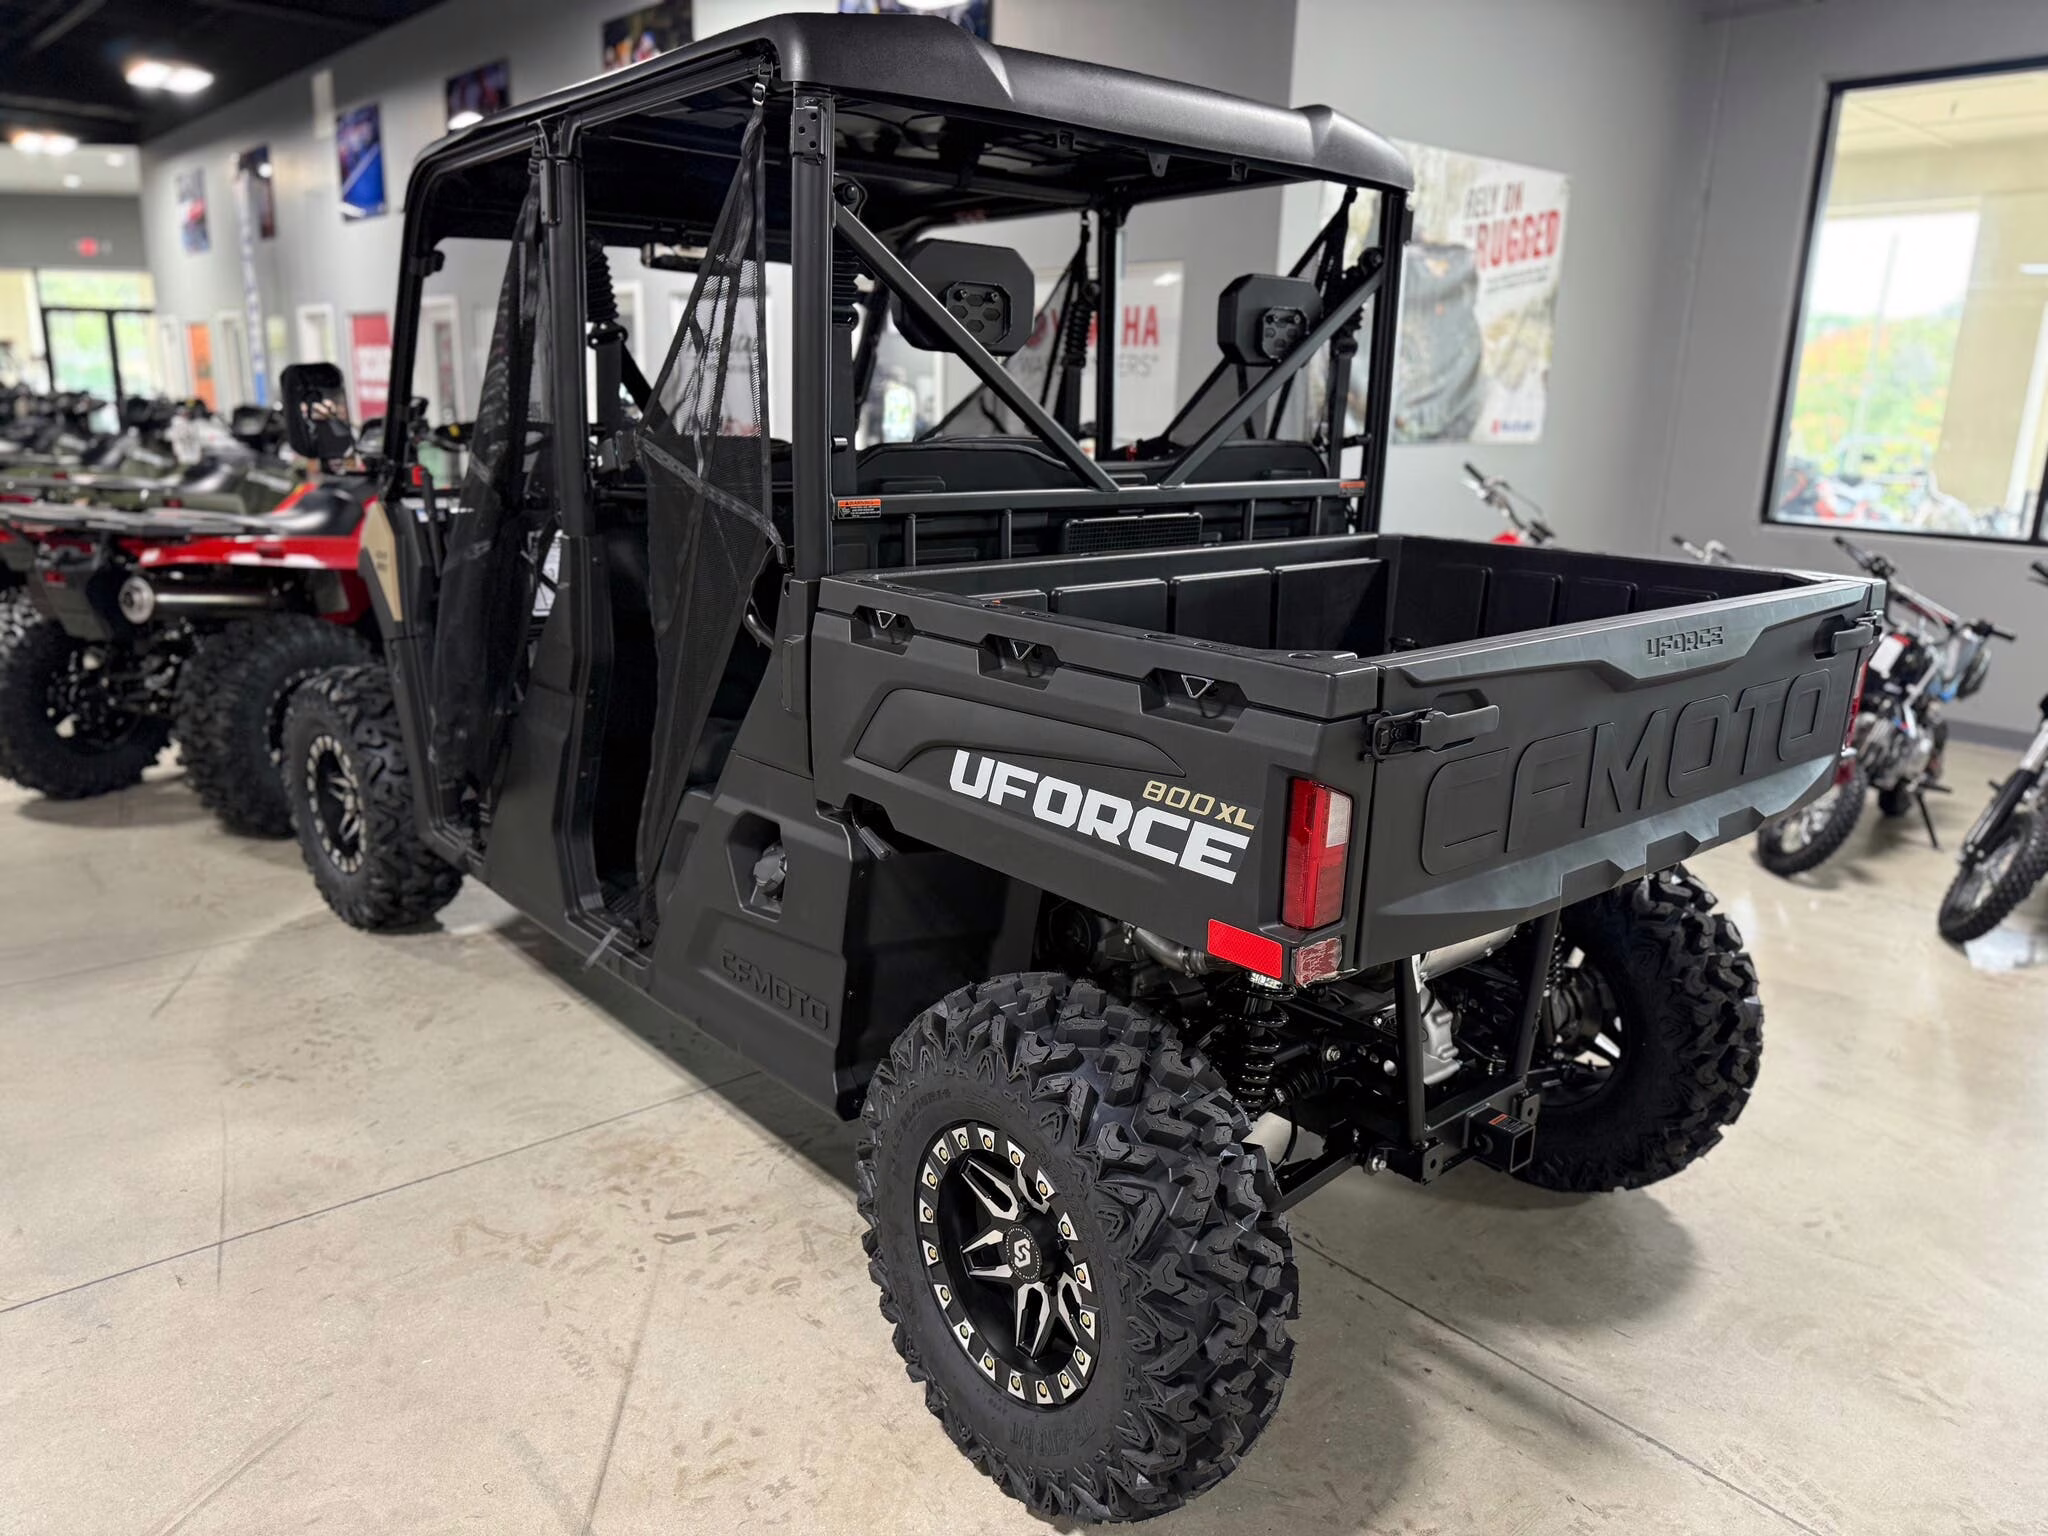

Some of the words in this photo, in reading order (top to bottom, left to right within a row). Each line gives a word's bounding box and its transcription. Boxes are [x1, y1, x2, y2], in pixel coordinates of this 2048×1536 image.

[1475, 208, 1561, 271] RUGGED
[1646, 625, 1724, 660] UFORCE
[1421, 668, 1832, 877] CFMOTO
[949, 749, 1251, 885] UFORCE
[720, 947, 830, 1032] CFMOTO
